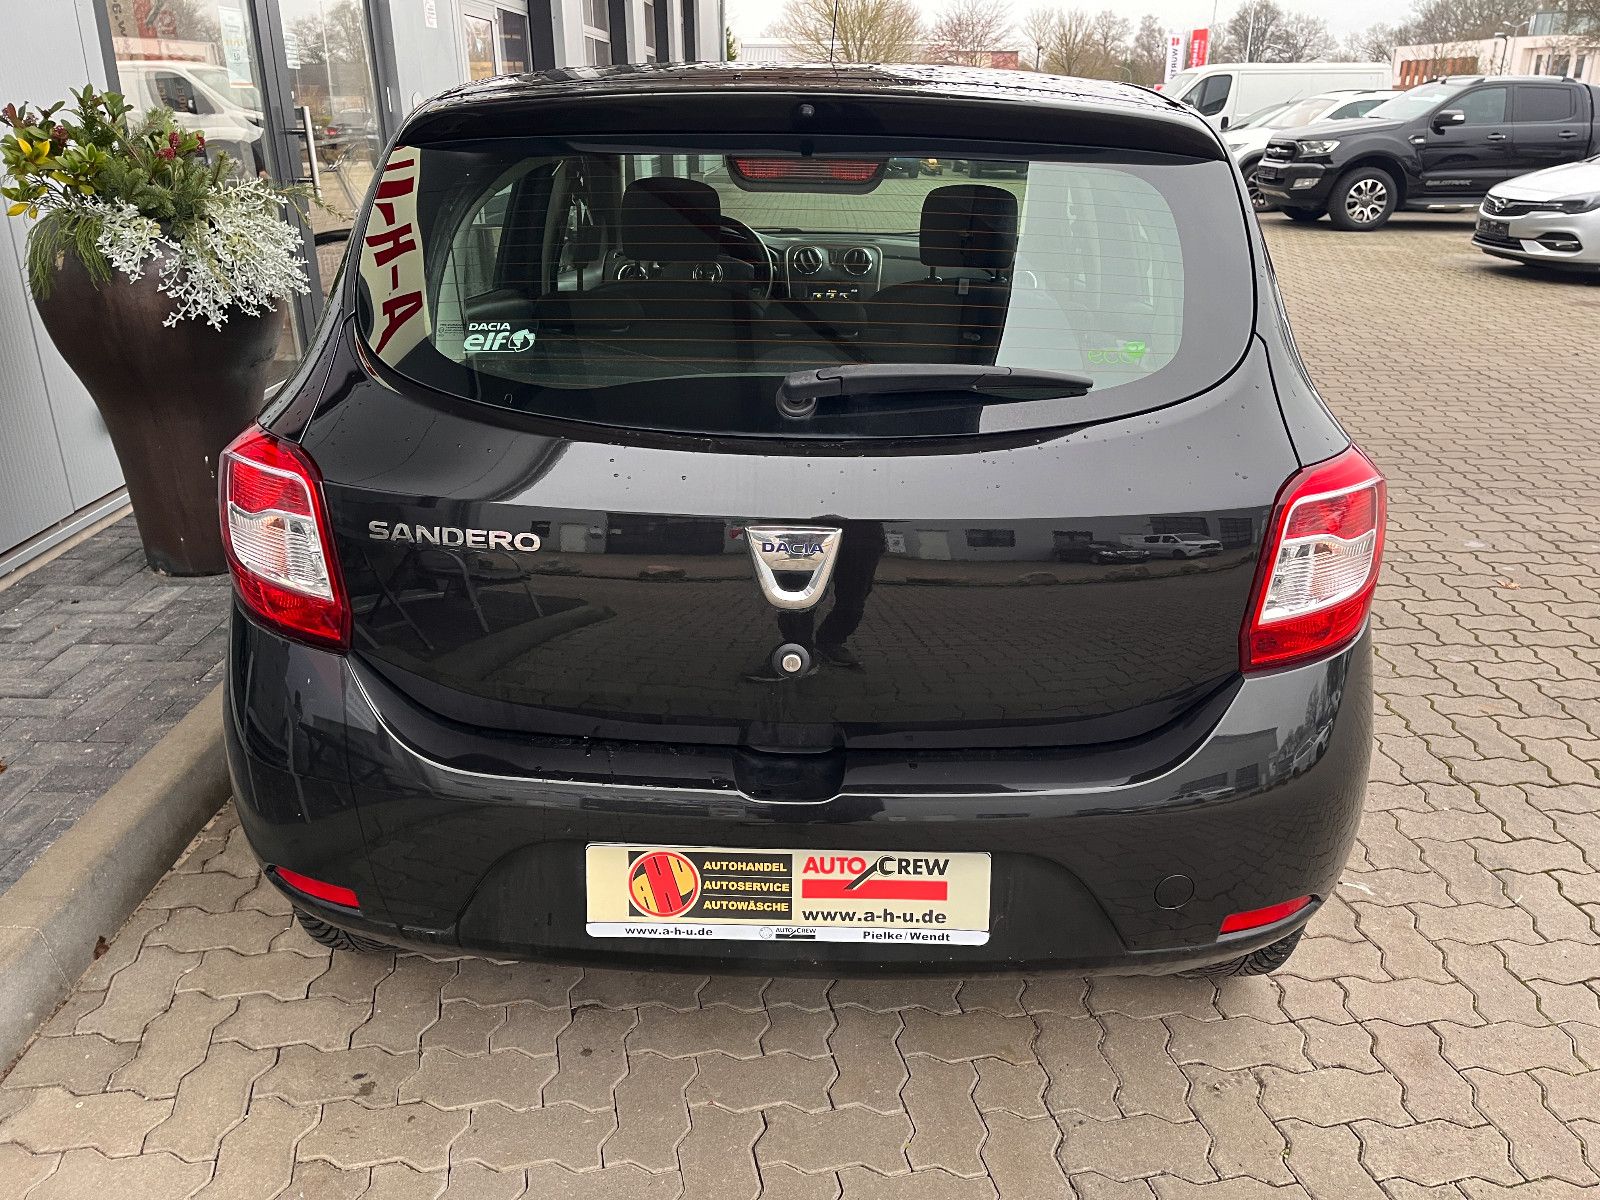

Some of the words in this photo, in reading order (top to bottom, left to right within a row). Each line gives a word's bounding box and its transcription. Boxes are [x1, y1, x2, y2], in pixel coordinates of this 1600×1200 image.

[469, 323, 511, 331] DACIA
[463, 331, 510, 351] elf
[368, 520, 541, 552] SANDERO
[761, 542, 824, 555] DACIA
[703, 861, 787, 872] AUTOHANDEL
[803, 856, 867, 875] AUTO
[878, 856, 950, 876] CREW
[703, 881, 790, 892] AUTOSERVICE
[703, 900, 789, 912] AUTOWÄSCHE
[802, 909, 947, 923] www.a-h-u.de
[625, 927, 713, 936] www.a-h-u.de
[863, 931, 951, 942] Pielke/Wendt
